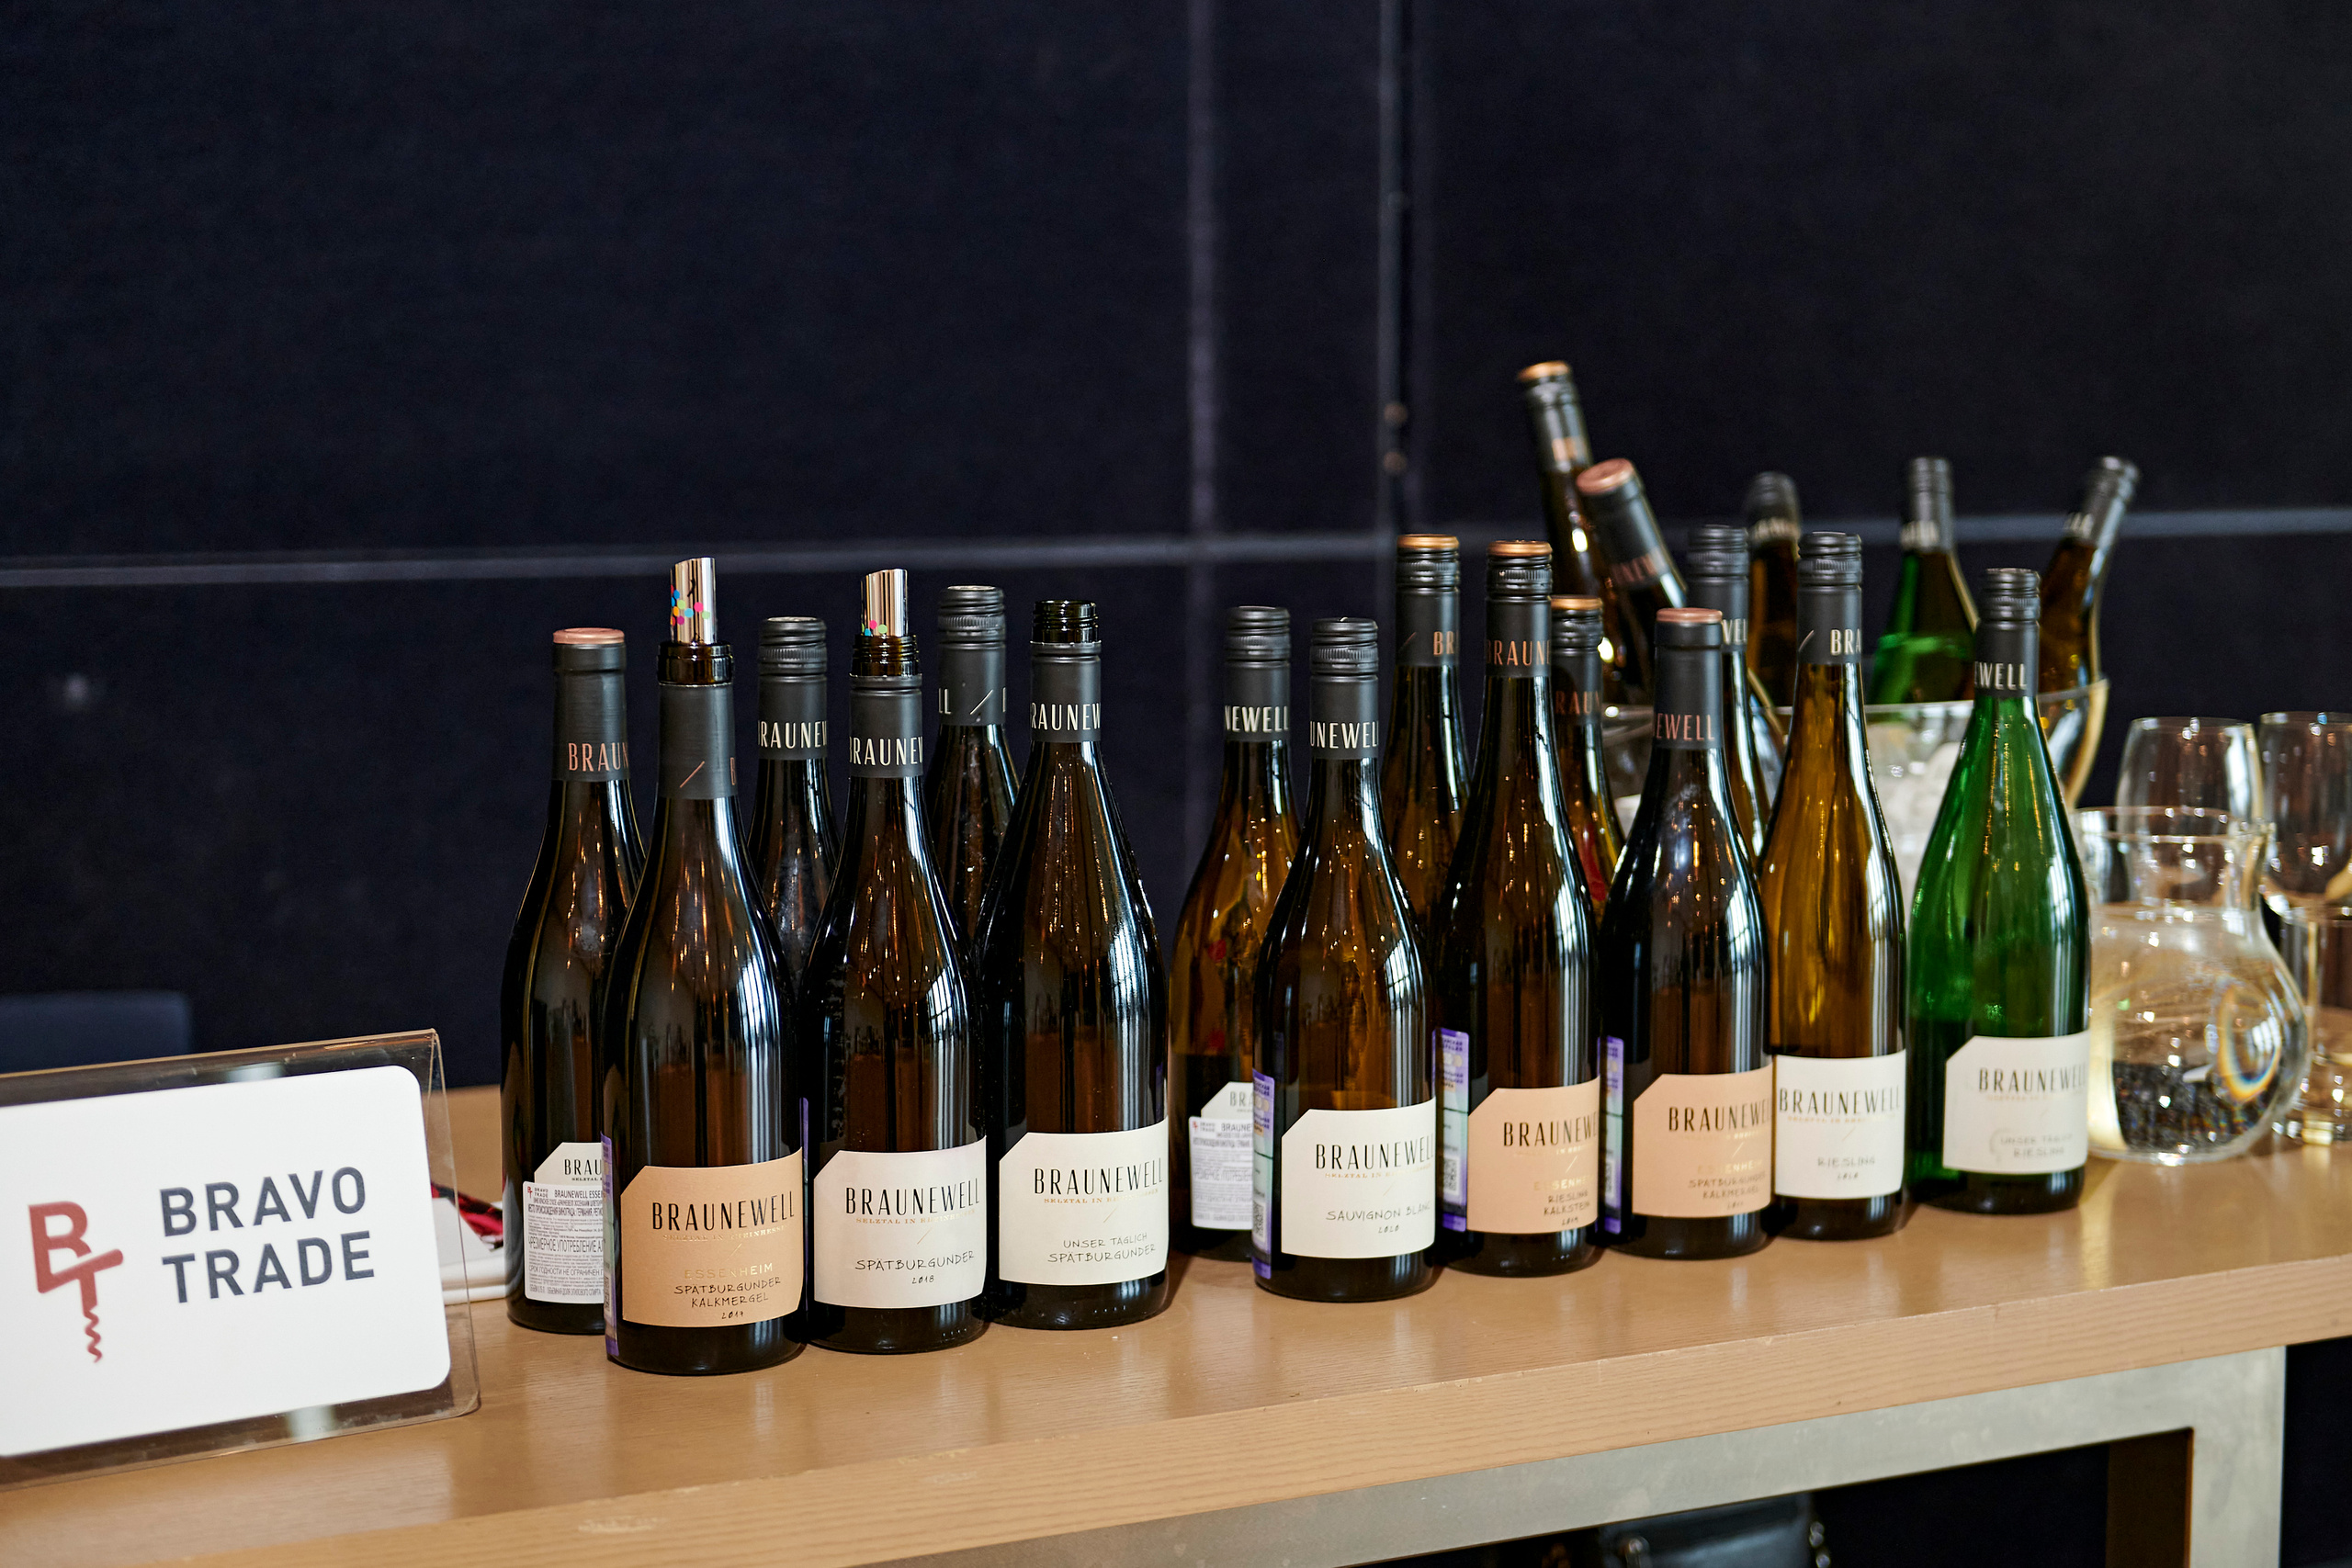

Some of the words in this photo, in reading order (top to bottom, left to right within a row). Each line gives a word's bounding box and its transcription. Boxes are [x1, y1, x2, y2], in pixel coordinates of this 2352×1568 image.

[1433, 631, 1459, 657] BR
[1779, 1086, 1900, 1115] BRAUNEWELL
[1034, 1157, 1163, 1195] BRAUNEWELL
[159, 1166, 368, 1238] BRAVO
[845, 1178, 980, 1216] BRAUNEWELL
[651, 1190, 796, 1232] BRAUNEWELL
[1325, 1208, 1401, 1222] SAUVIGNON
[1047, 1243, 1157, 1264] SPÄTBURGUNDER
[1063, 1238, 1106, 1249] UNSER
[161, 1230, 375, 1303] TRADE
[854, 1249, 975, 1271] SPÄTBURGUNDER
[684, 1262, 774, 1280] ESSENHEIM
[911, 1274, 935, 1285] 2018
[673, 1276, 782, 1295] SPÄTBURGUNDER
[691, 1292, 770, 1309] KALKMERGEL
[721, 1310, 745, 1320] 2017
